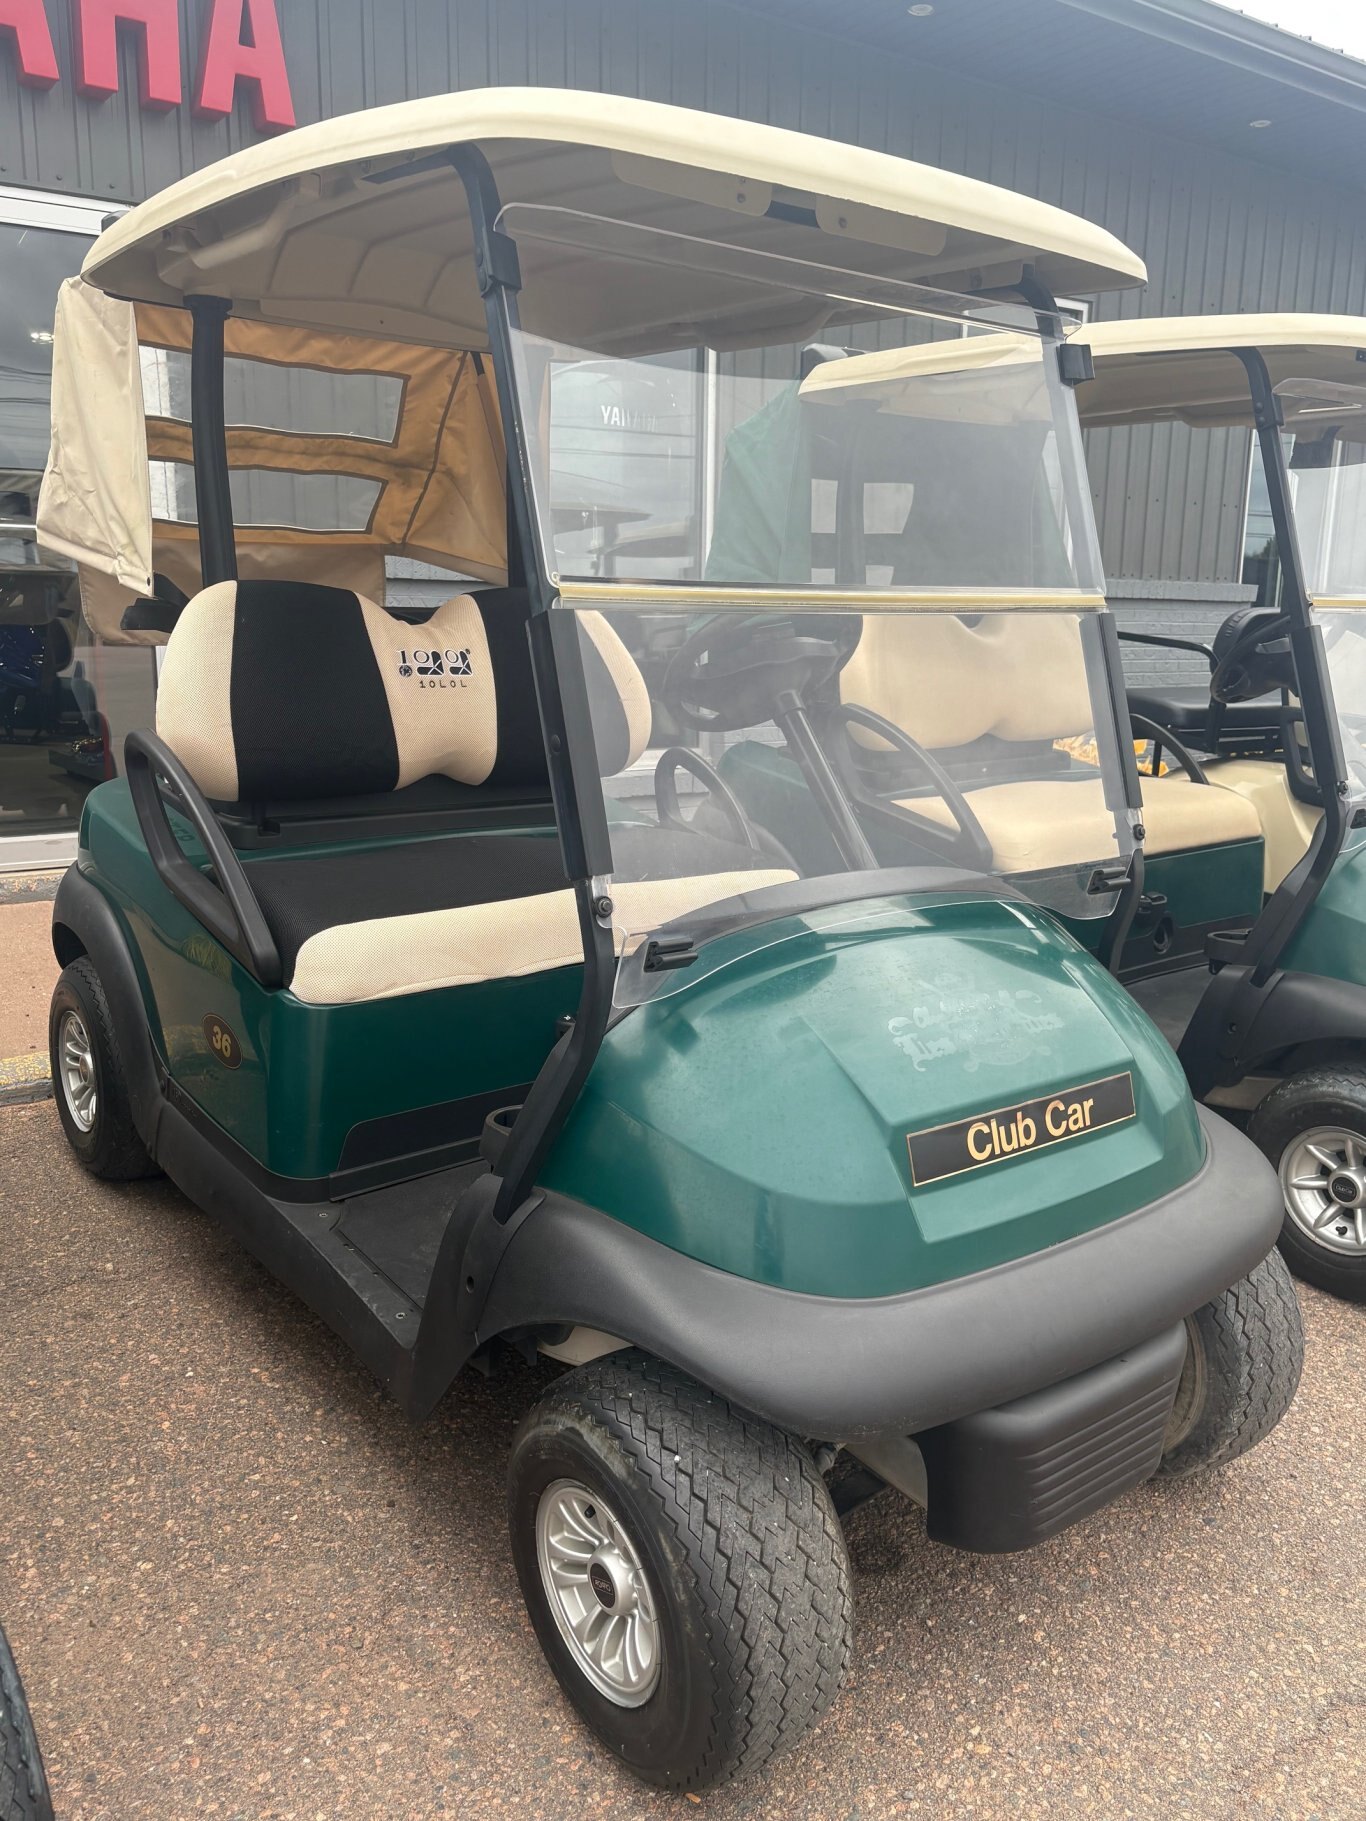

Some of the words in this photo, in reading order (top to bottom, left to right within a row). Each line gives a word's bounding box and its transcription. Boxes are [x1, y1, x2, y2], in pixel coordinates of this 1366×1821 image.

[212, 1025, 231, 1057] 36
[966, 1111, 1037, 1161] Club
[1045, 1098, 1094, 1137] Car
